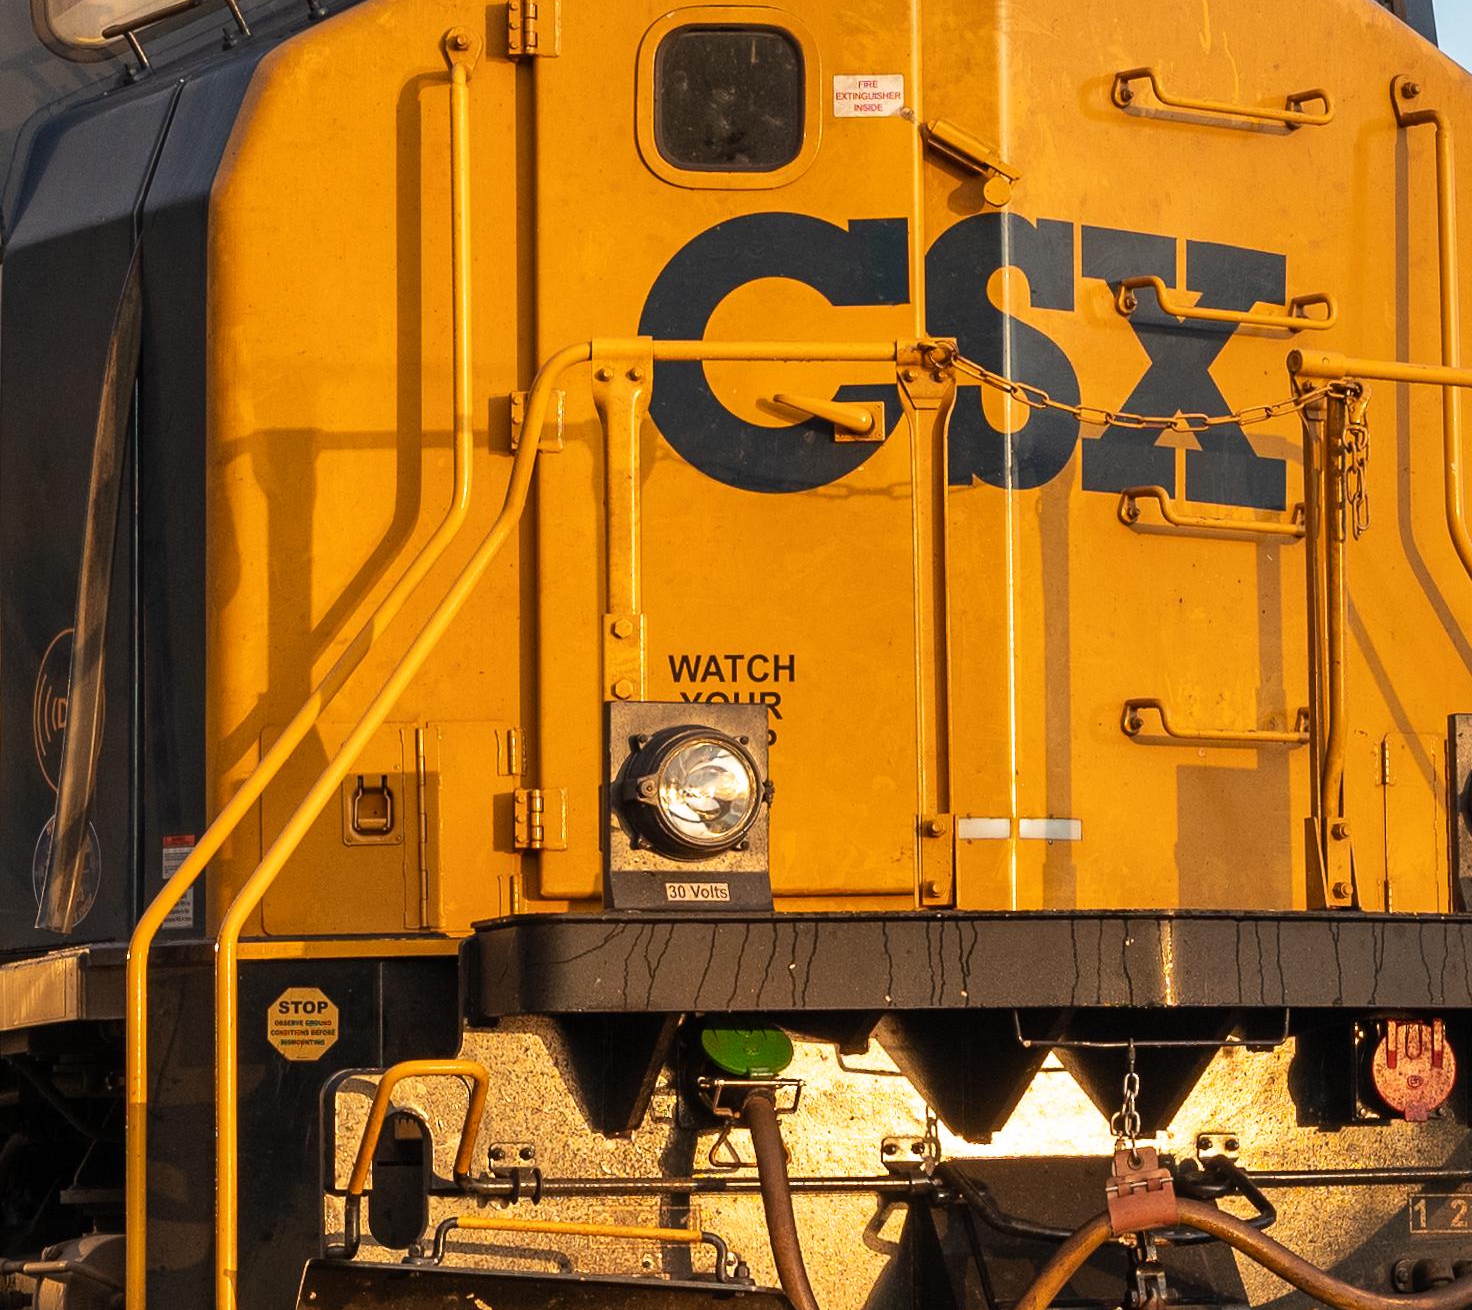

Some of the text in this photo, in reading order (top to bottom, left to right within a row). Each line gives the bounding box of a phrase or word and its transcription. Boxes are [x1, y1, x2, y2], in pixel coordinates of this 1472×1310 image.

[858, 80, 878, 89] FIRE
[835, 91, 901, 101] EXTINGUISHER
[854, 103, 883, 112] INSIDE
[637, 211, 1287, 512] CSX
[668, 654, 796, 683] WATCH
[668, 884, 728, 899] 30 Volts
[278, 1001, 328, 1014] STOP
[1414, 1198, 1427, 1228] 1
[1450, 1199, 1468, 1227] 2
